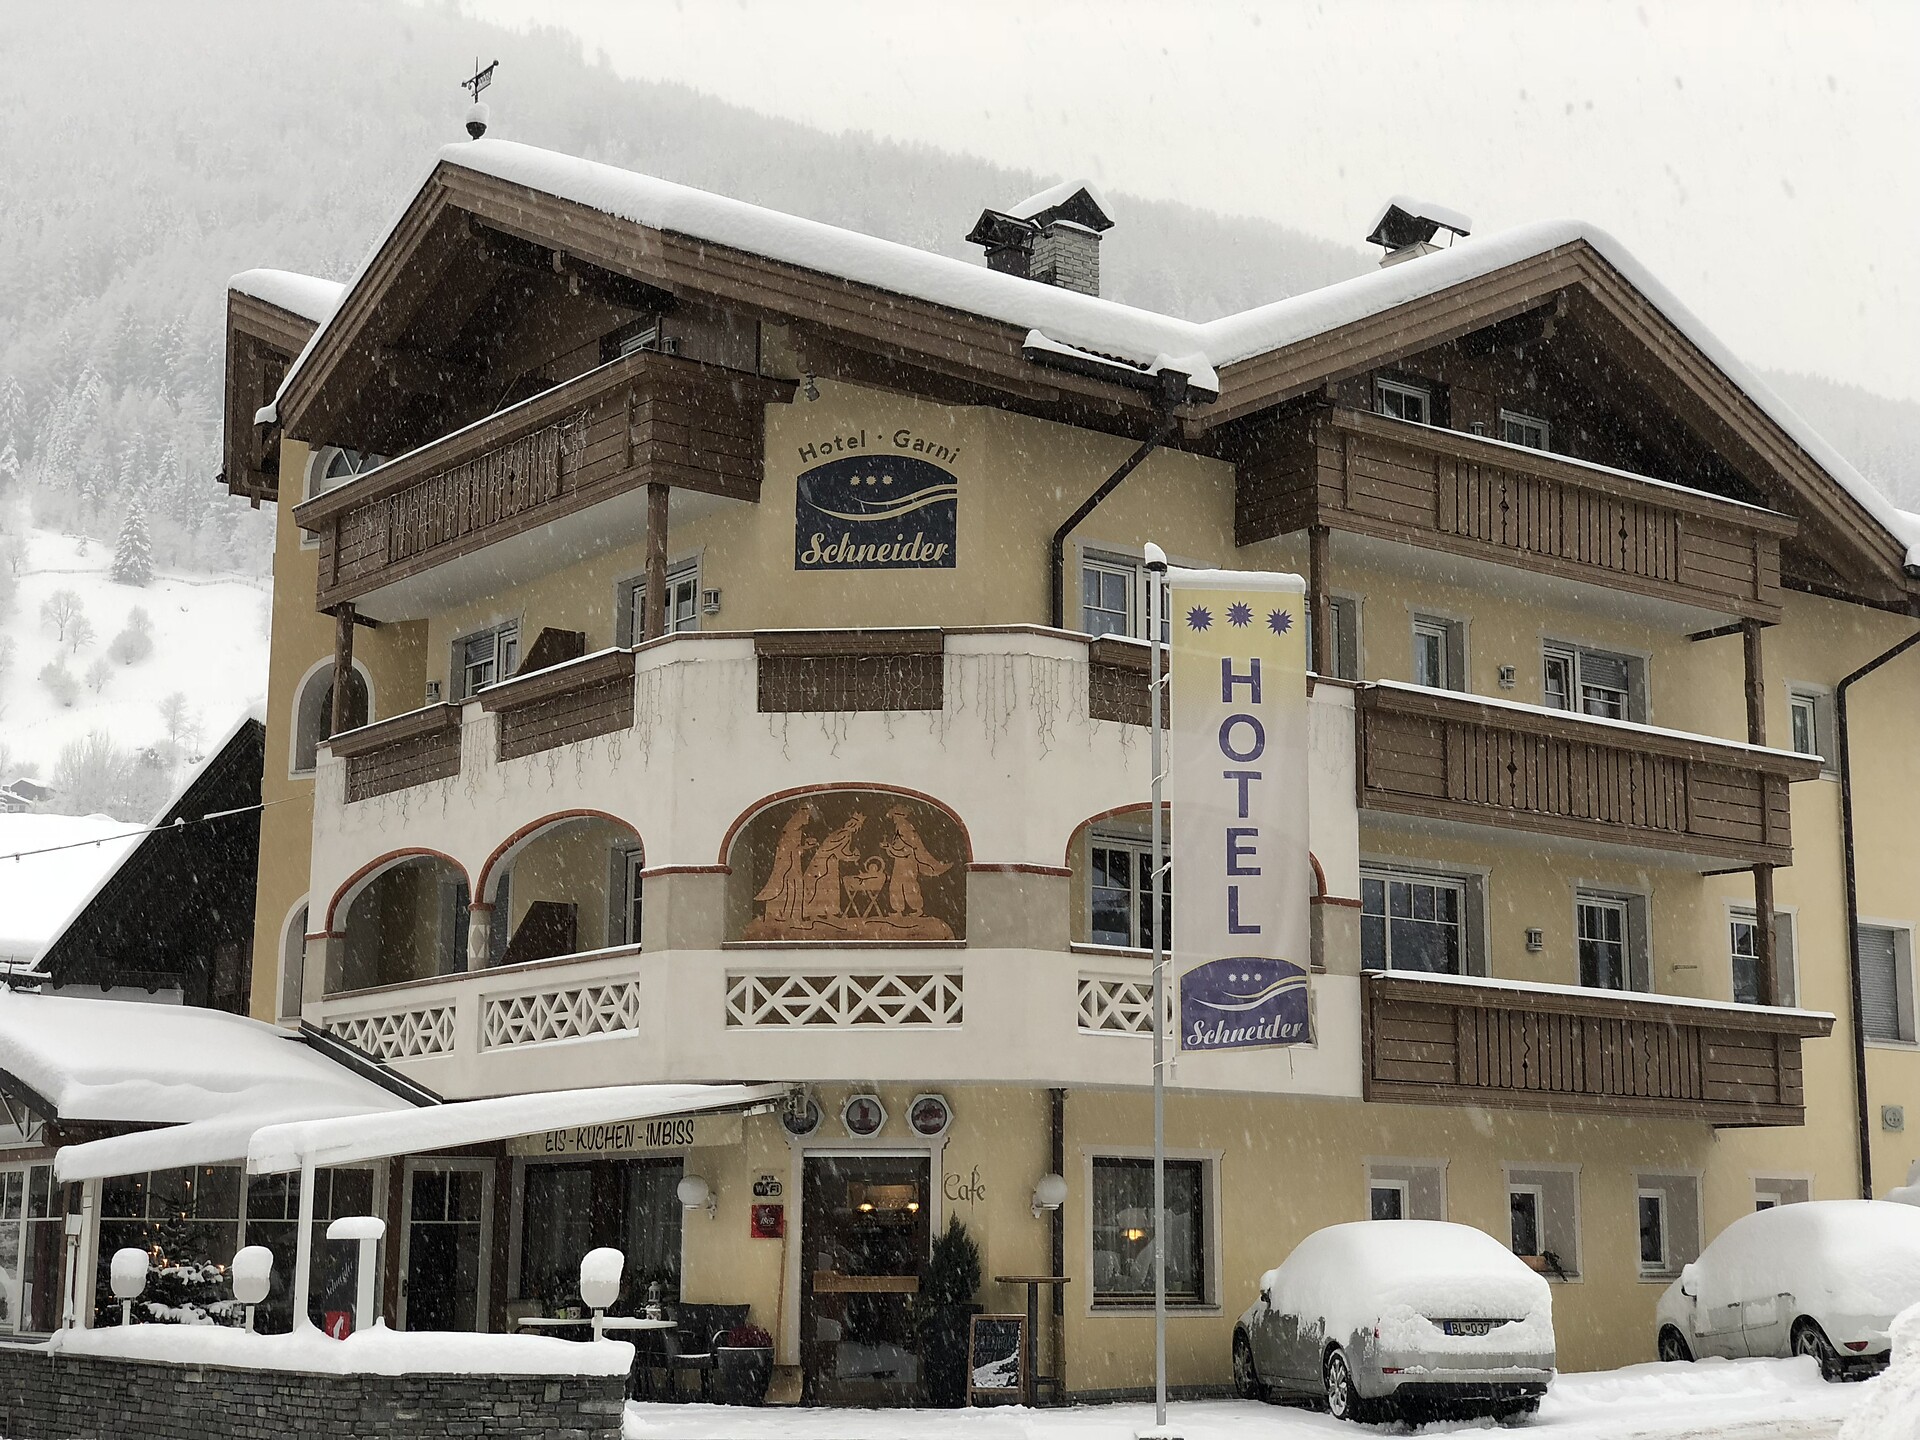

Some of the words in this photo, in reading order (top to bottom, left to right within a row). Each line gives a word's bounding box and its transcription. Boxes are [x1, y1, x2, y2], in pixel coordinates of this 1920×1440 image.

[798, 429, 866, 464] Hotel
[892, 429, 961, 464] Garni
[800, 531, 950, 564] Schneider
[1218, 657, 1266, 935] HOTEL
[1187, 1014, 1303, 1046] Schneider
[545, 1129, 567, 1152] EIS
[576, 1124, 635, 1151] KUCHEN
[646, 1119, 694, 1147] IMBISS
